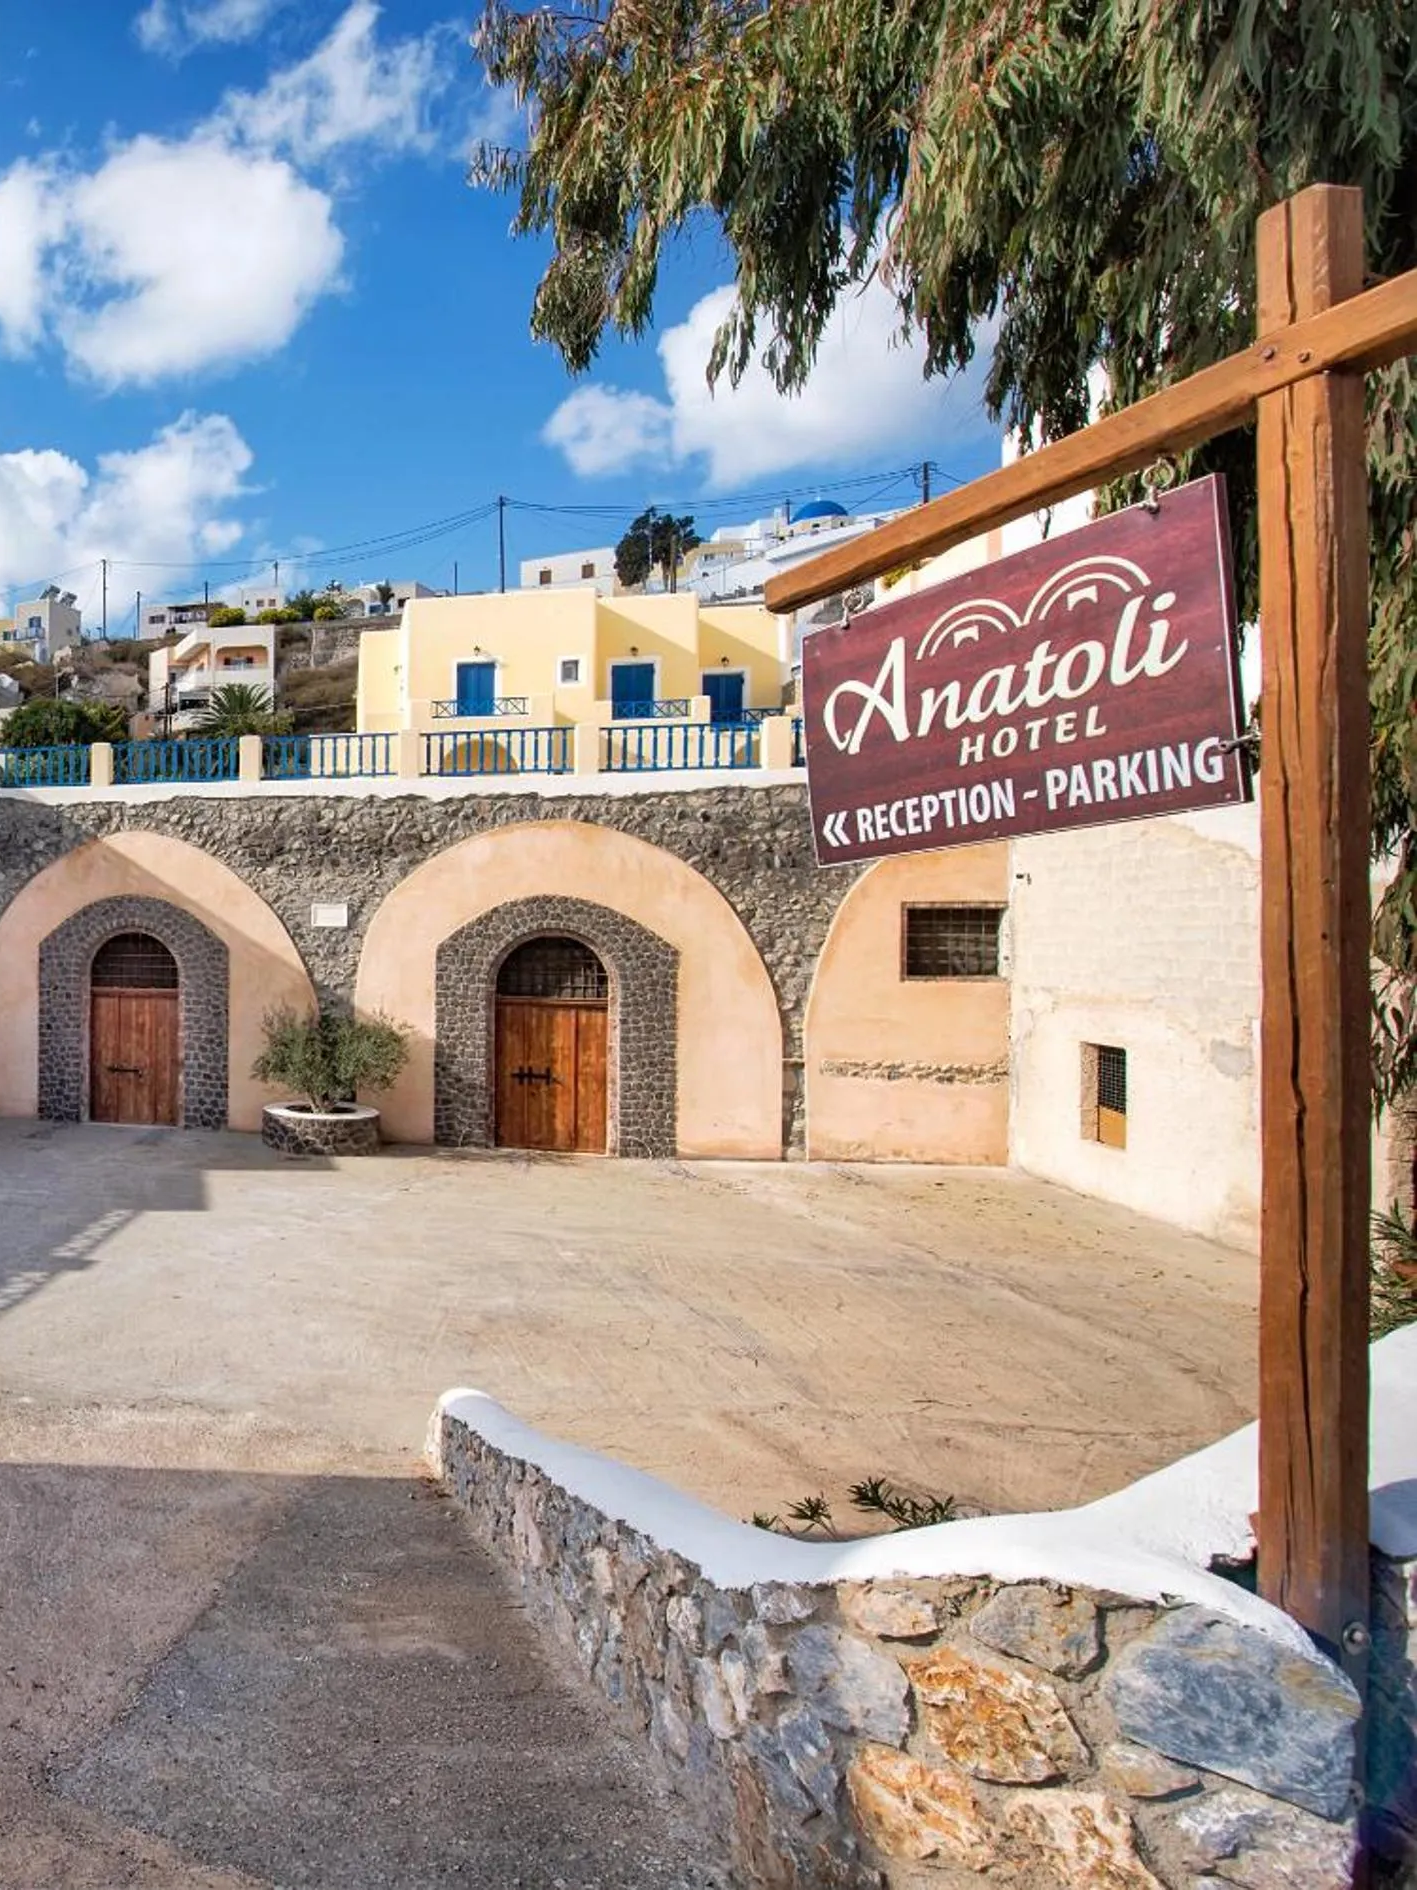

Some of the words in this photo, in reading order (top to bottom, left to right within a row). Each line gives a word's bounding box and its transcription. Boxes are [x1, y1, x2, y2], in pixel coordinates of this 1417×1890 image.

[823, 591, 1188, 755] Anatoli
[958, 705, 1107, 767] HOTEL
[857, 778, 1015, 843] RECEPTION
[1046, 737, 1225, 810] PARKING
